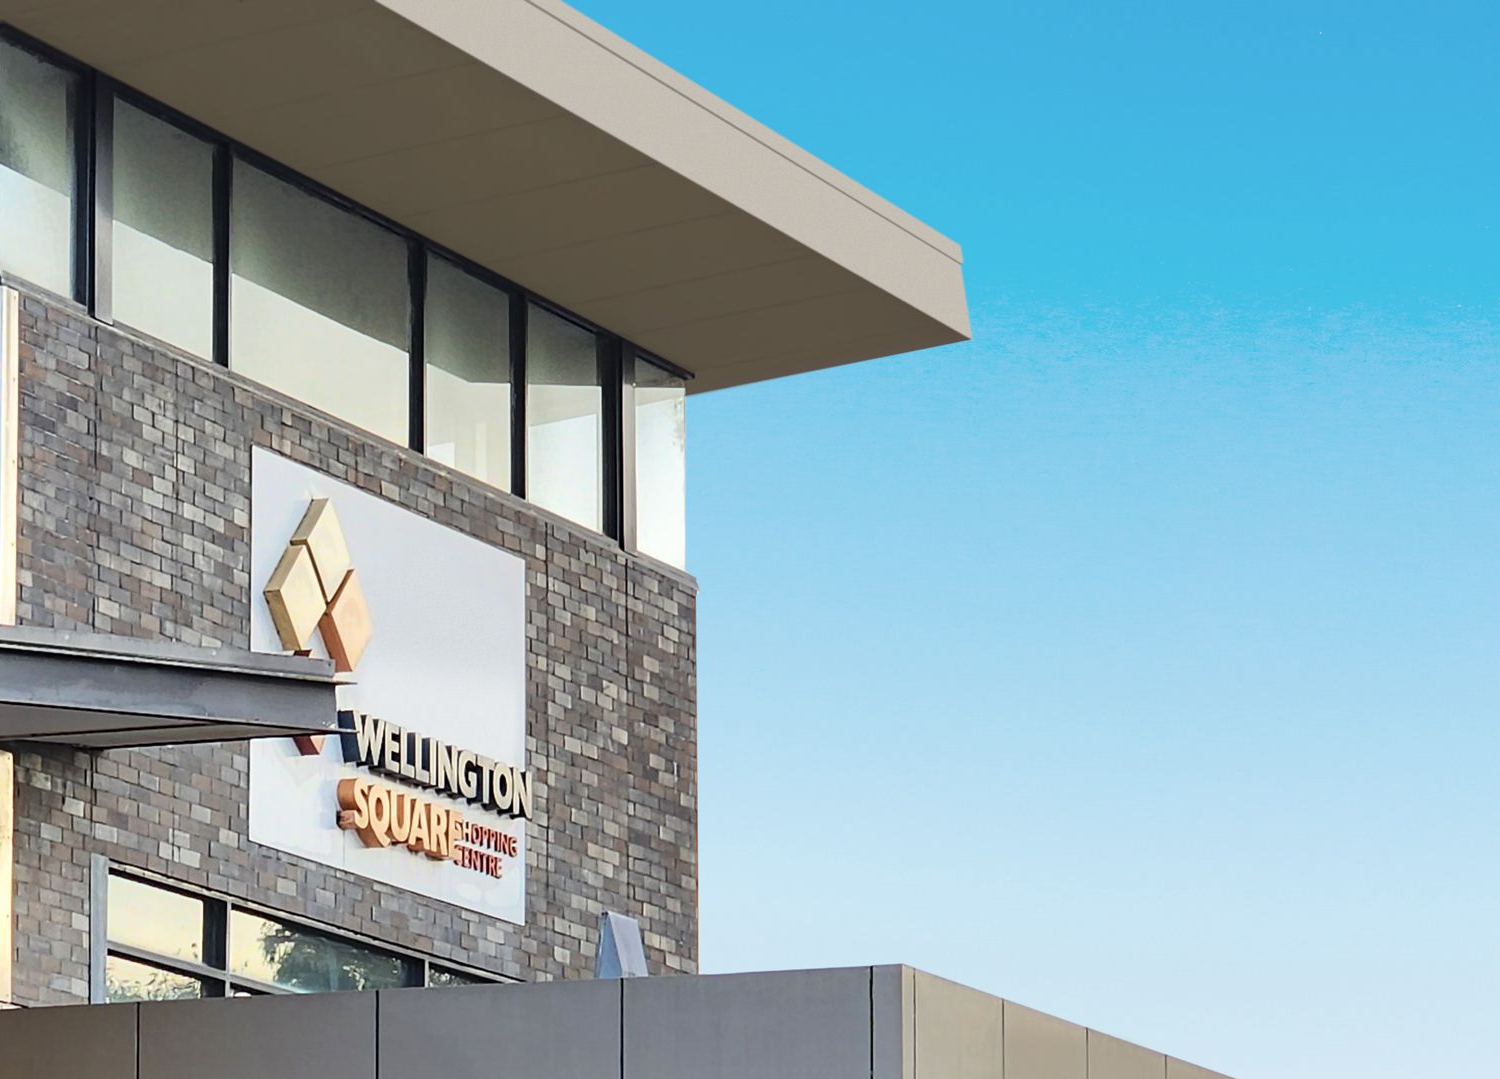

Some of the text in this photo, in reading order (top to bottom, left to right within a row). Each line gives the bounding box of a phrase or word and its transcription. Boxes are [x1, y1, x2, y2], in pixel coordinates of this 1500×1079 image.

[352, 709, 533, 820] WELLINGTON
[352, 777, 463, 861] SQUARE
[454, 819, 518, 857] SHOPPING
[454, 844, 503, 880] CENTRE
